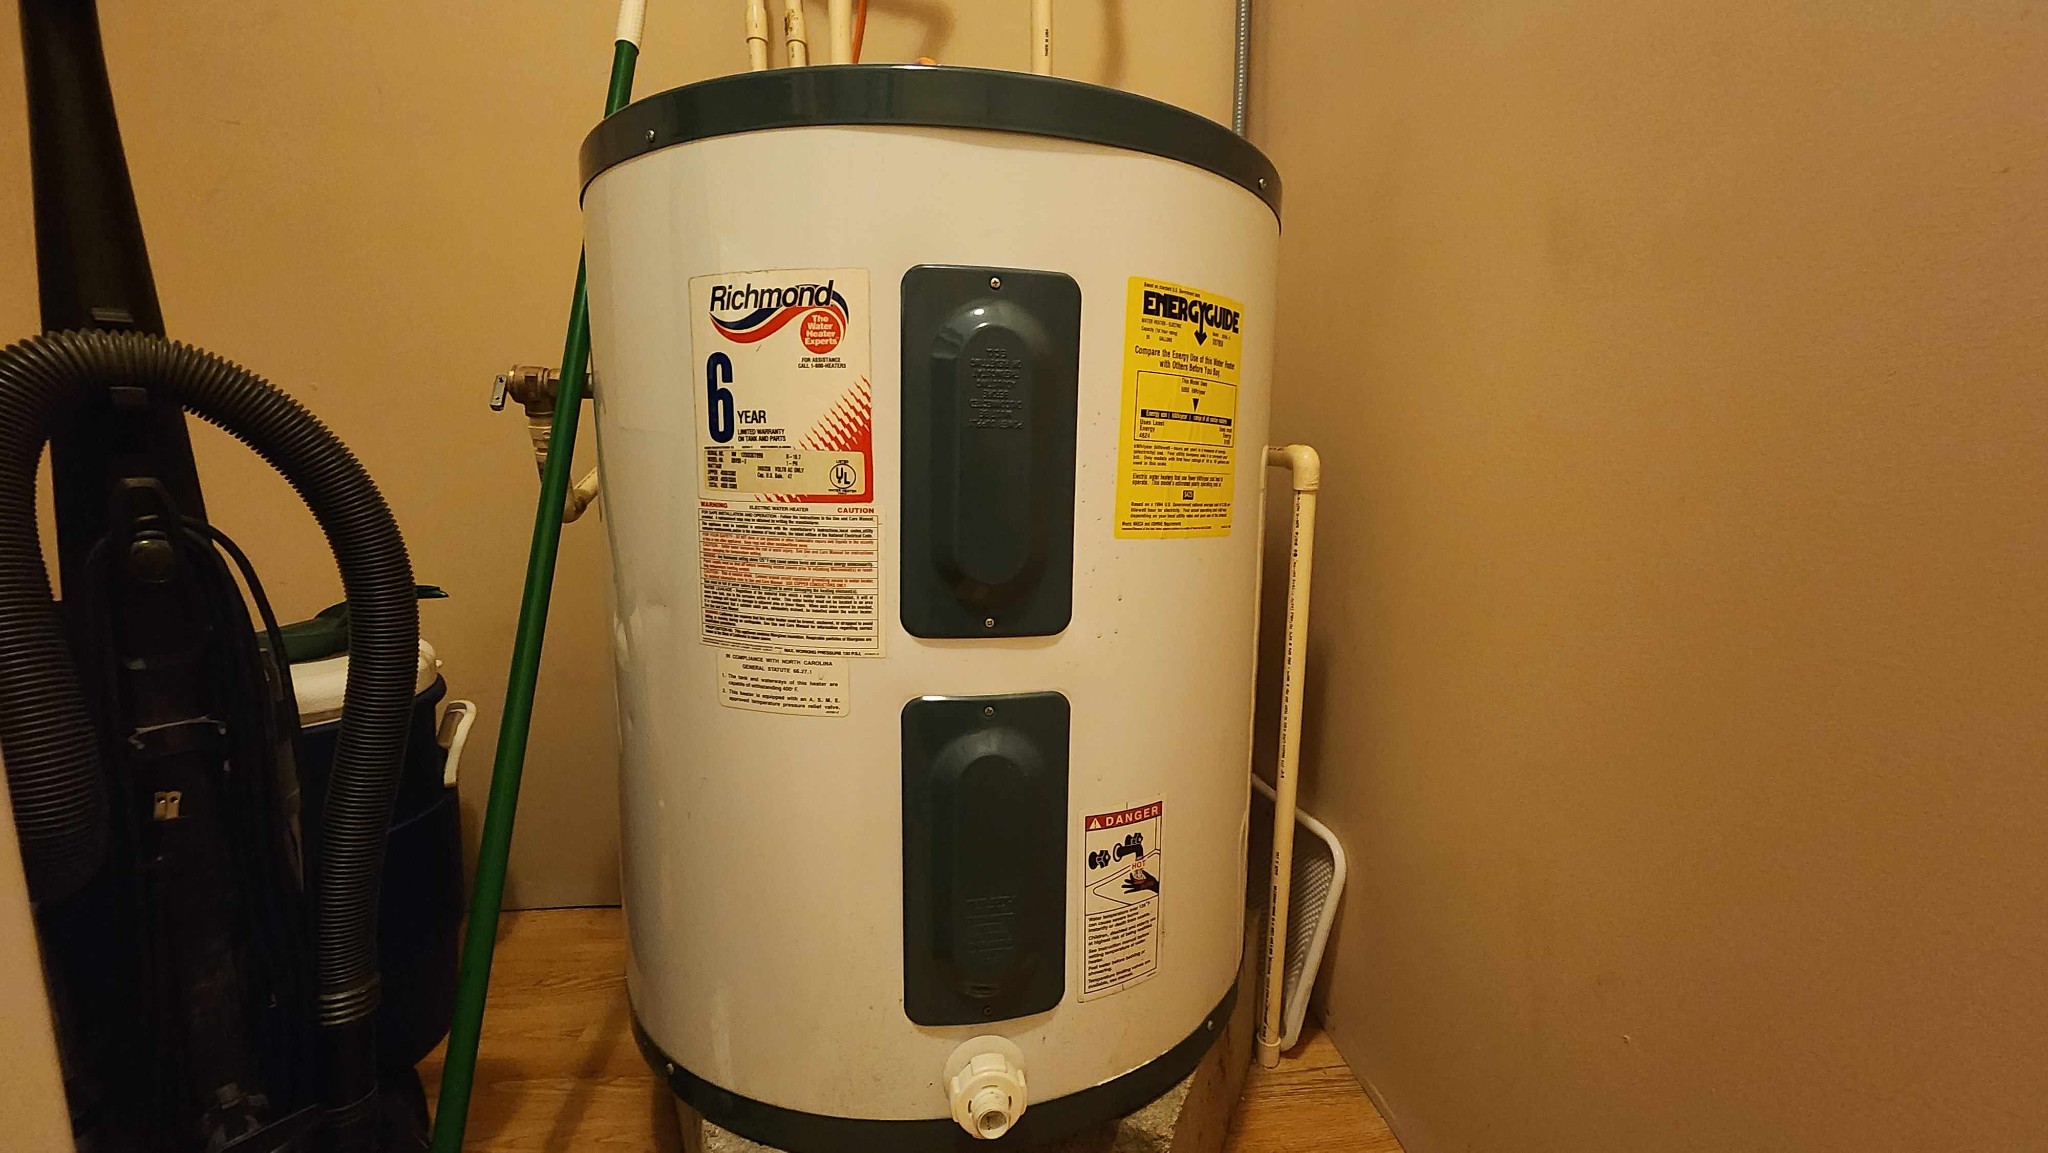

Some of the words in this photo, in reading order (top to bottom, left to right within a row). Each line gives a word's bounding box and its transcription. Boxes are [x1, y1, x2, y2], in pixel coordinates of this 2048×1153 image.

[709, 280, 834, 312] Richmond
[1143, 290, 1240, 334] ENERGYGUIDE
[804, 338, 837, 346] Experts
[1135, 345, 1160, 357] Compare
[1162, 349, 1170, 357] the
[1172, 350, 1189, 362] Energy
[1190, 354, 1198, 362] Use
[1214, 358, 1224, 367] Water
[1225, 361, 1235, 370] Heater
[1160, 360, 1170, 368] with
[1172, 361, 1188, 371] Others
[1190, 364, 1203, 374] Before
[1204, 366, 1212, 375] You
[706, 352, 735, 443] 6
[736, 410, 767, 424] YEAR
[732, 654, 763, 662] COMPLIANCE
[751, 684, 782, 692] withstanding
[1106, 806, 1158, 826] DANGER
[1131, 860, 1146, 870] HOT
